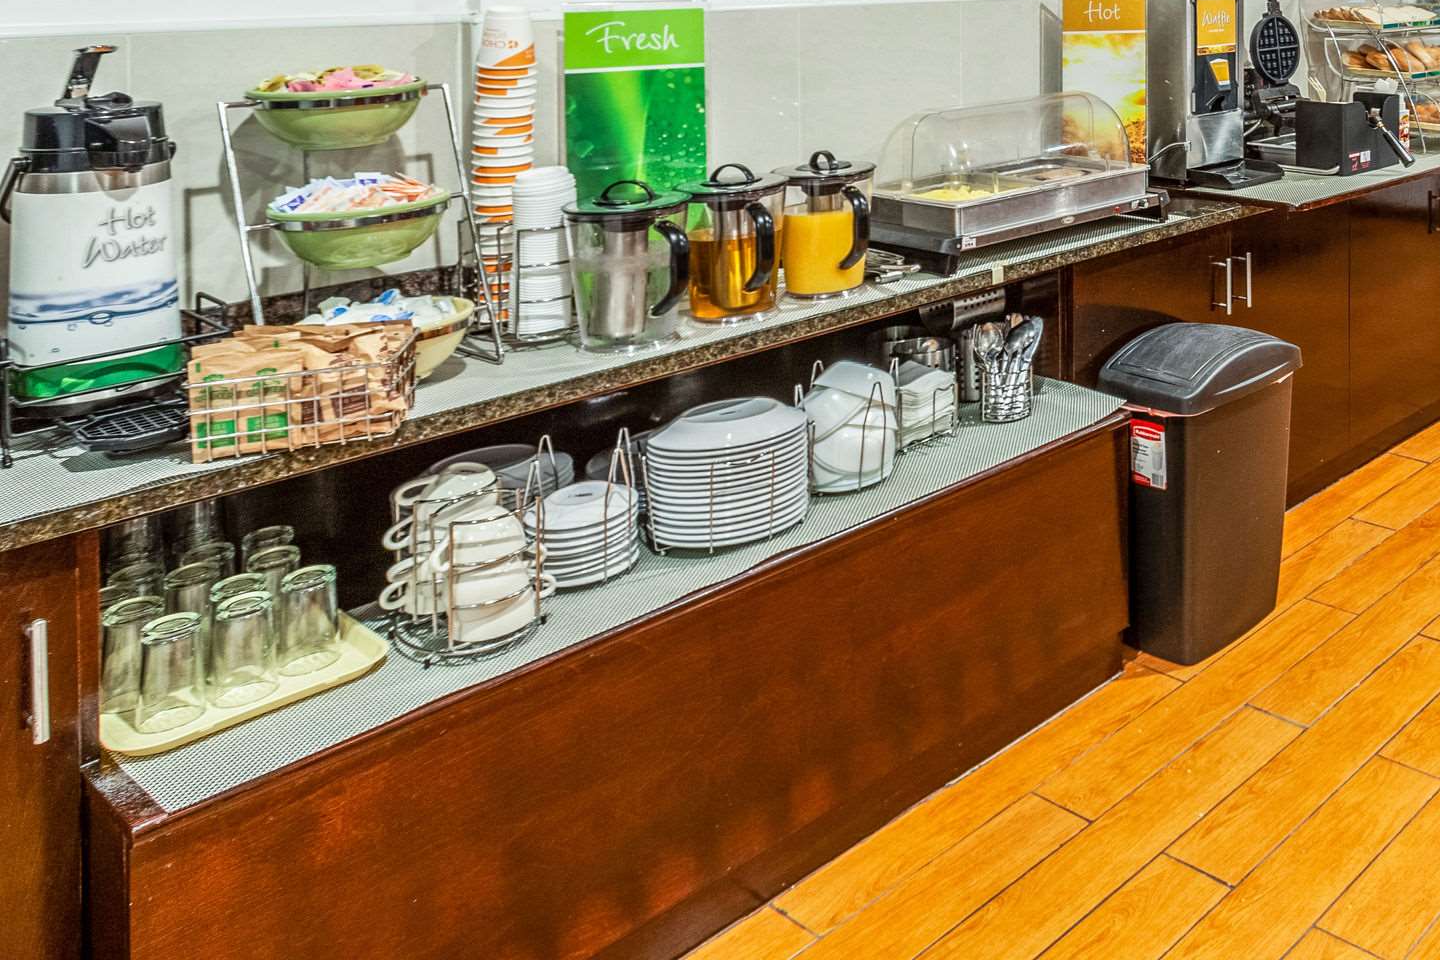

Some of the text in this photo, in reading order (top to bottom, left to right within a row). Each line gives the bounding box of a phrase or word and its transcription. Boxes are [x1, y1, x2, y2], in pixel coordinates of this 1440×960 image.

[1082, 0, 1121, 23] Hot
[584, 20, 680, 54] Fresh
[98, 206, 156, 237] Hot
[81, 235, 169, 269] Water
